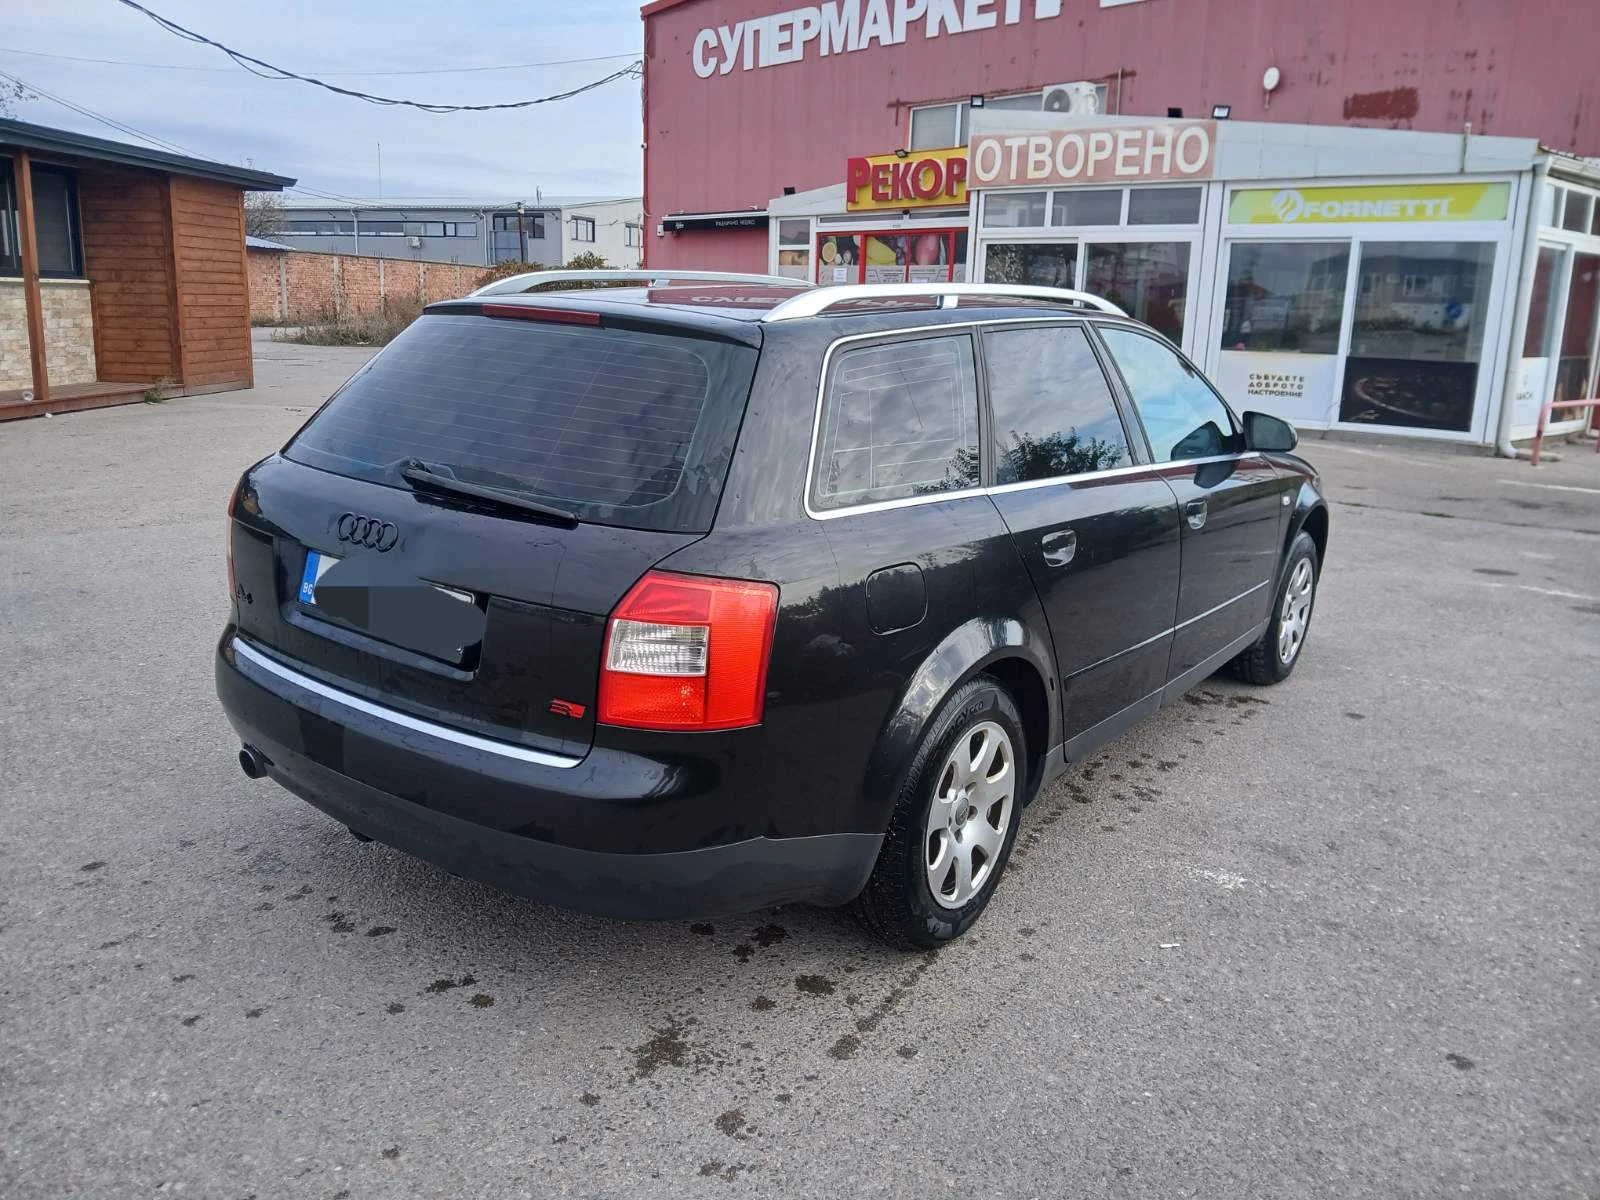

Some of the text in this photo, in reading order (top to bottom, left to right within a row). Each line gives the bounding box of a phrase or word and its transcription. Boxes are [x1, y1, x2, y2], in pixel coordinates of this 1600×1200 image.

[975, 126, 1210, 182] ОТВОРЕНО
[847, 156, 970, 204] РЕКОР
[1302, 197, 1453, 219] FORNETTI
[1247, 389, 1304, 398] НАСТРОЕНИЕ
[303, 582, 314, 595] BG
